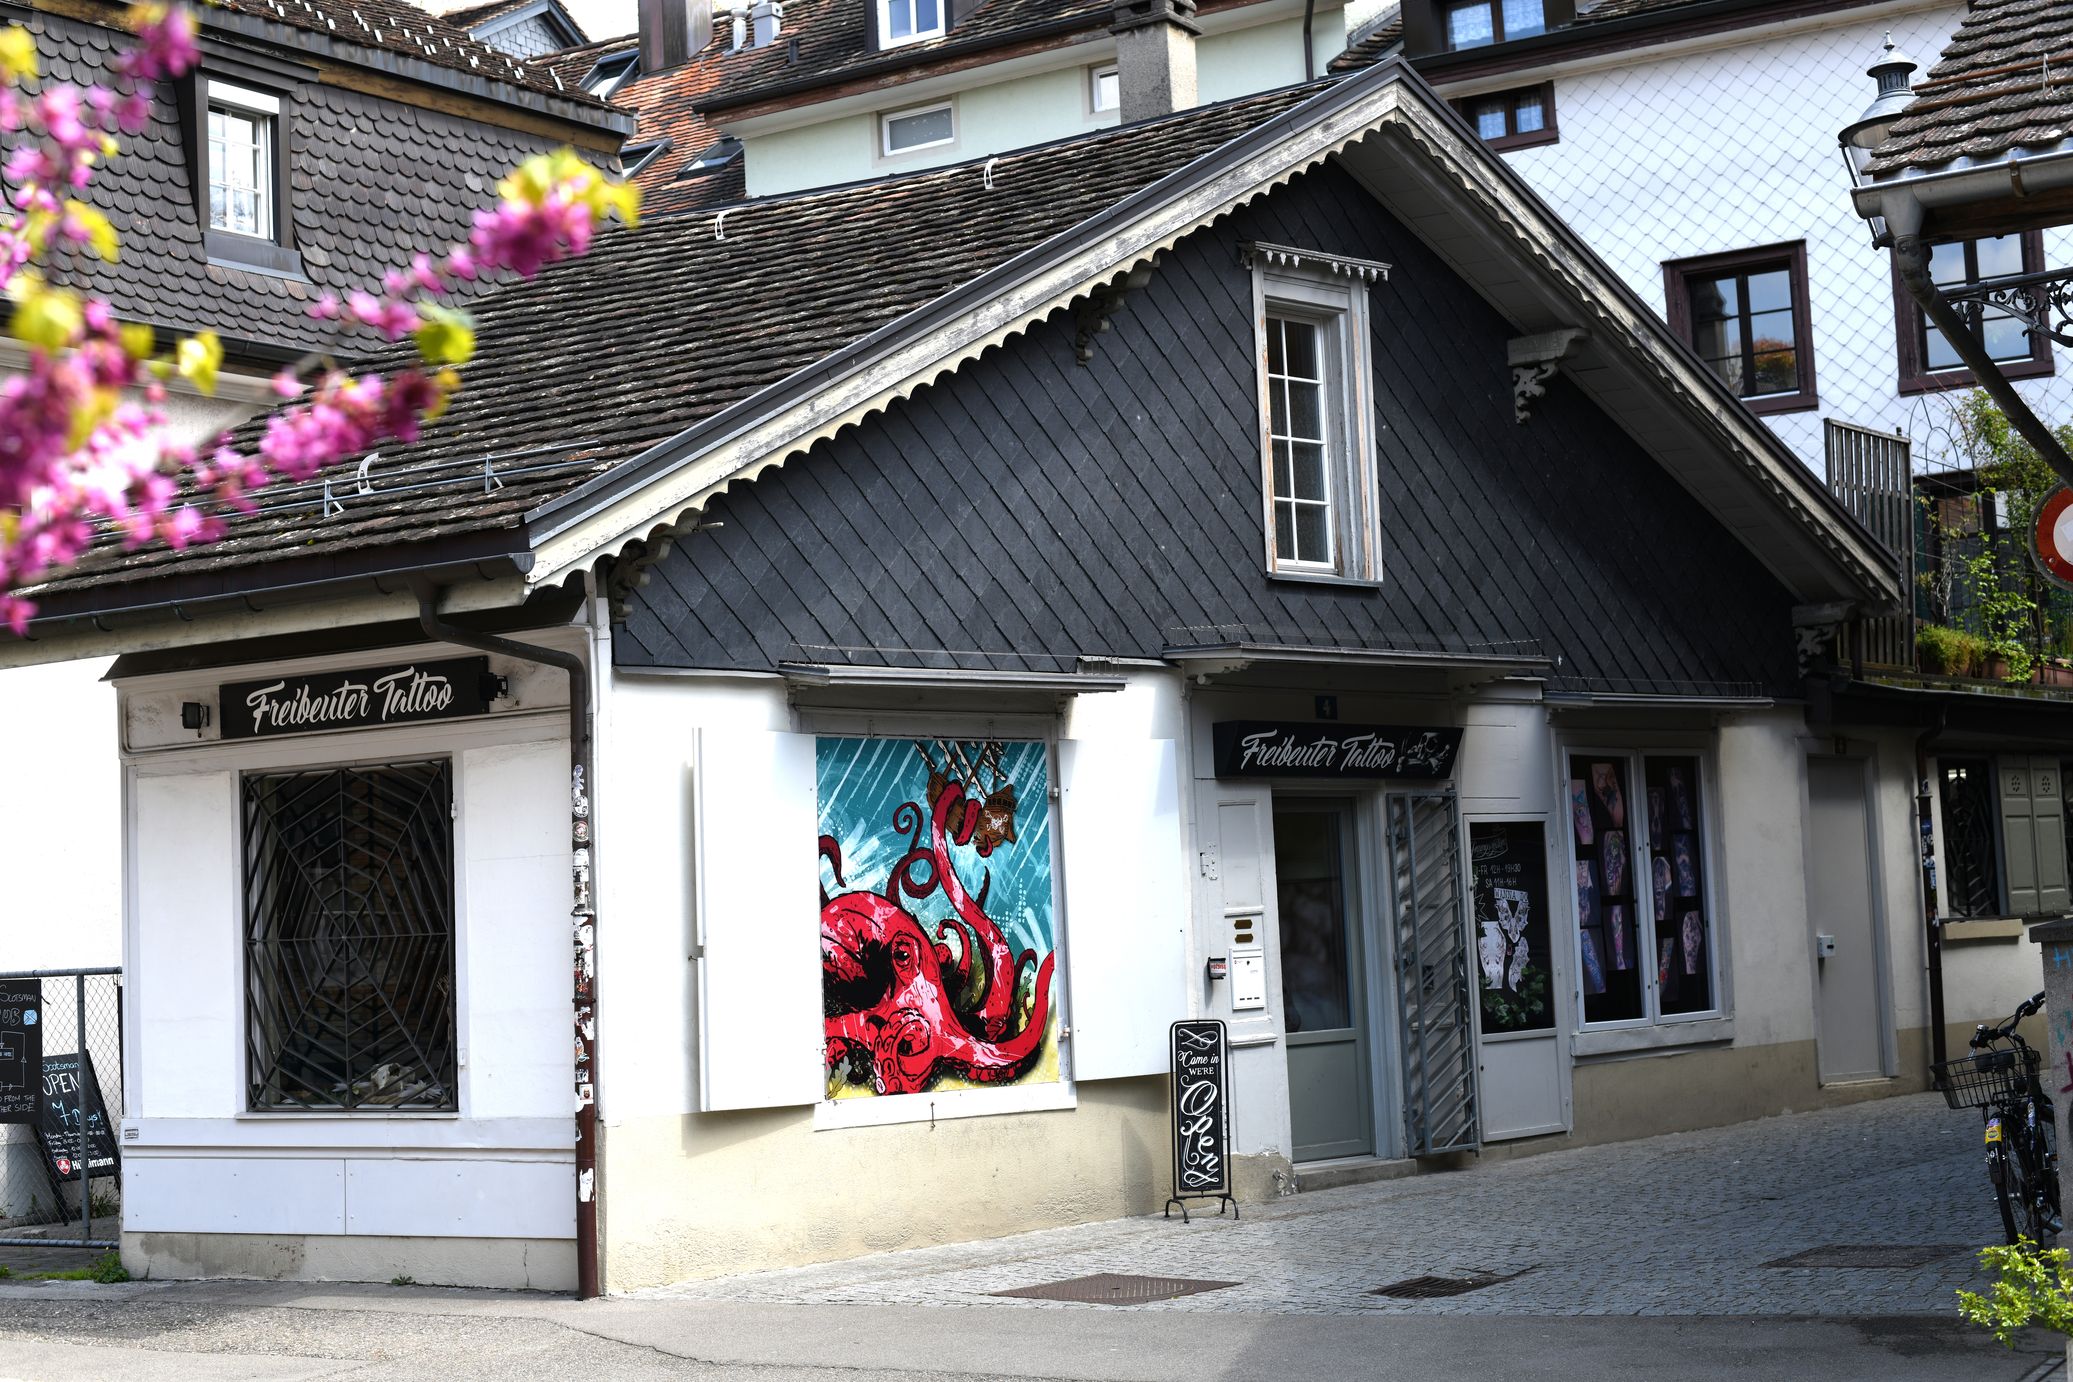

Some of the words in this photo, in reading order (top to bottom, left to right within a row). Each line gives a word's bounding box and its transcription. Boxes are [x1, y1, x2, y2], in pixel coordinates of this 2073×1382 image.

[246, 680, 371, 734] Freibeuter
[373, 666, 454, 721] Tattoo
[1241, 728, 1338, 770] Freibeuter
[1340, 731, 1395, 771] Tattoo
[0, 1007, 21, 1027] UB
[1178, 1050, 1209, 1068] Come
[1210, 1053, 1220, 1065] in
[14, 1102, 36, 1113] SIDE
[1180, 1074, 1220, 1174] Open
